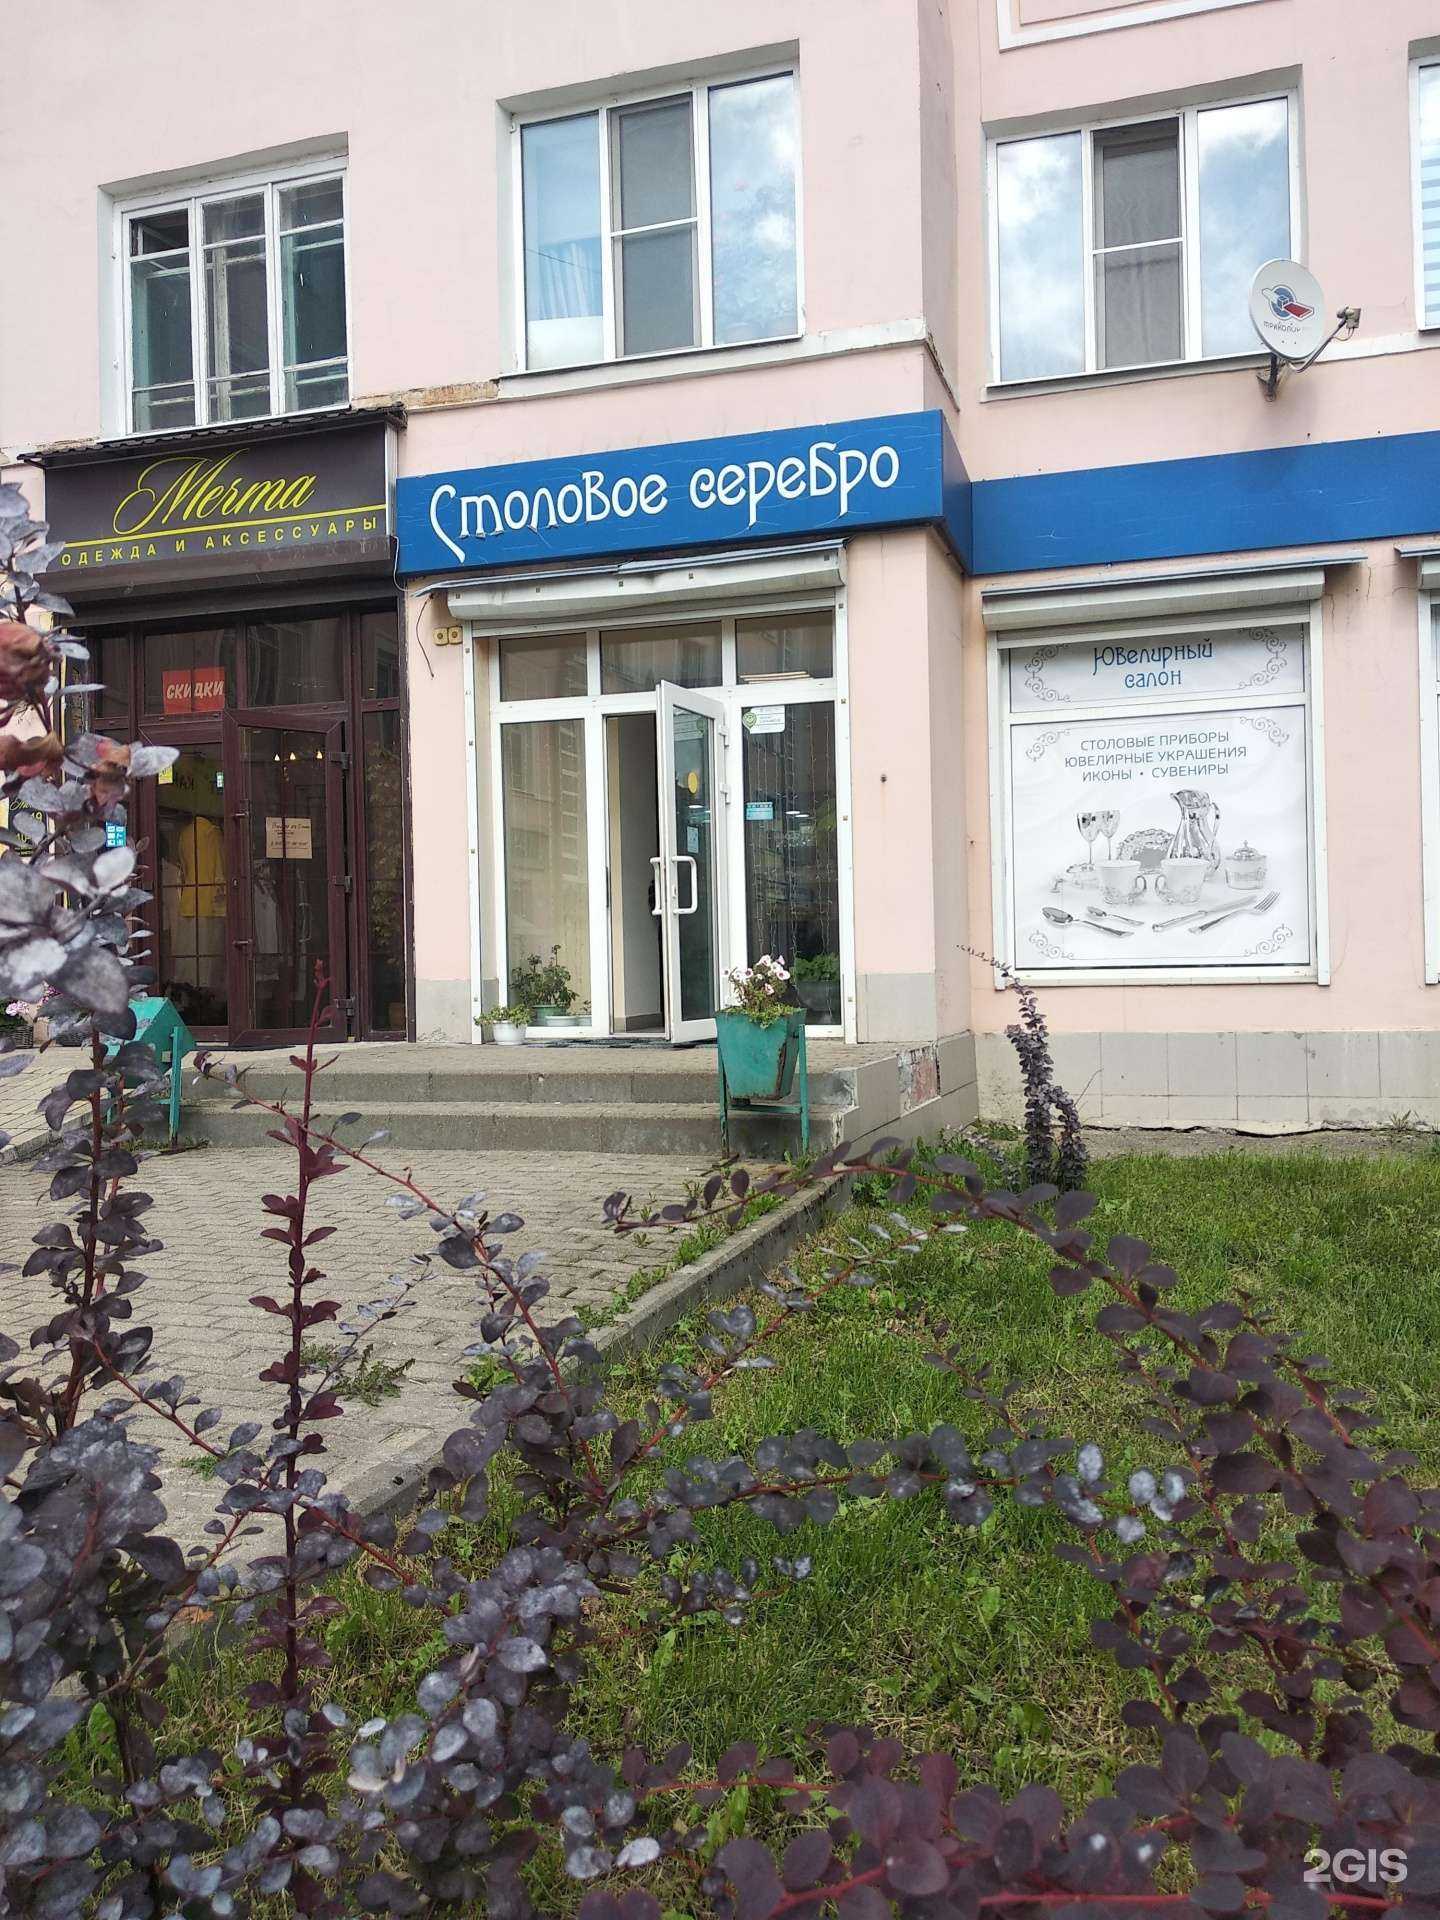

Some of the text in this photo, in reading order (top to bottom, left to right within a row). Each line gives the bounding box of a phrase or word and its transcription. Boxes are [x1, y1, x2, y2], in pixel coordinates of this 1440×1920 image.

[113, 447, 319, 535] Мечта
[60, 515, 378, 567] ОДЕЖДА И АКСЕССУАРЫ
[1092, 638, 1214, 676] Ювелирный
[1124, 669, 1182, 689] салон
[166, 680, 225, 700] СКИДКИ
[1080, 731, 1230, 751] СТОЛОВЫЕ ПРИБОРЫ
[1064, 746, 1248, 768] ЮВЕЛИРНЫЕ УКРАШЕНИЯ
[1082, 763, 1230, 783] ИКОНЫ СУВЕНИРЫ
